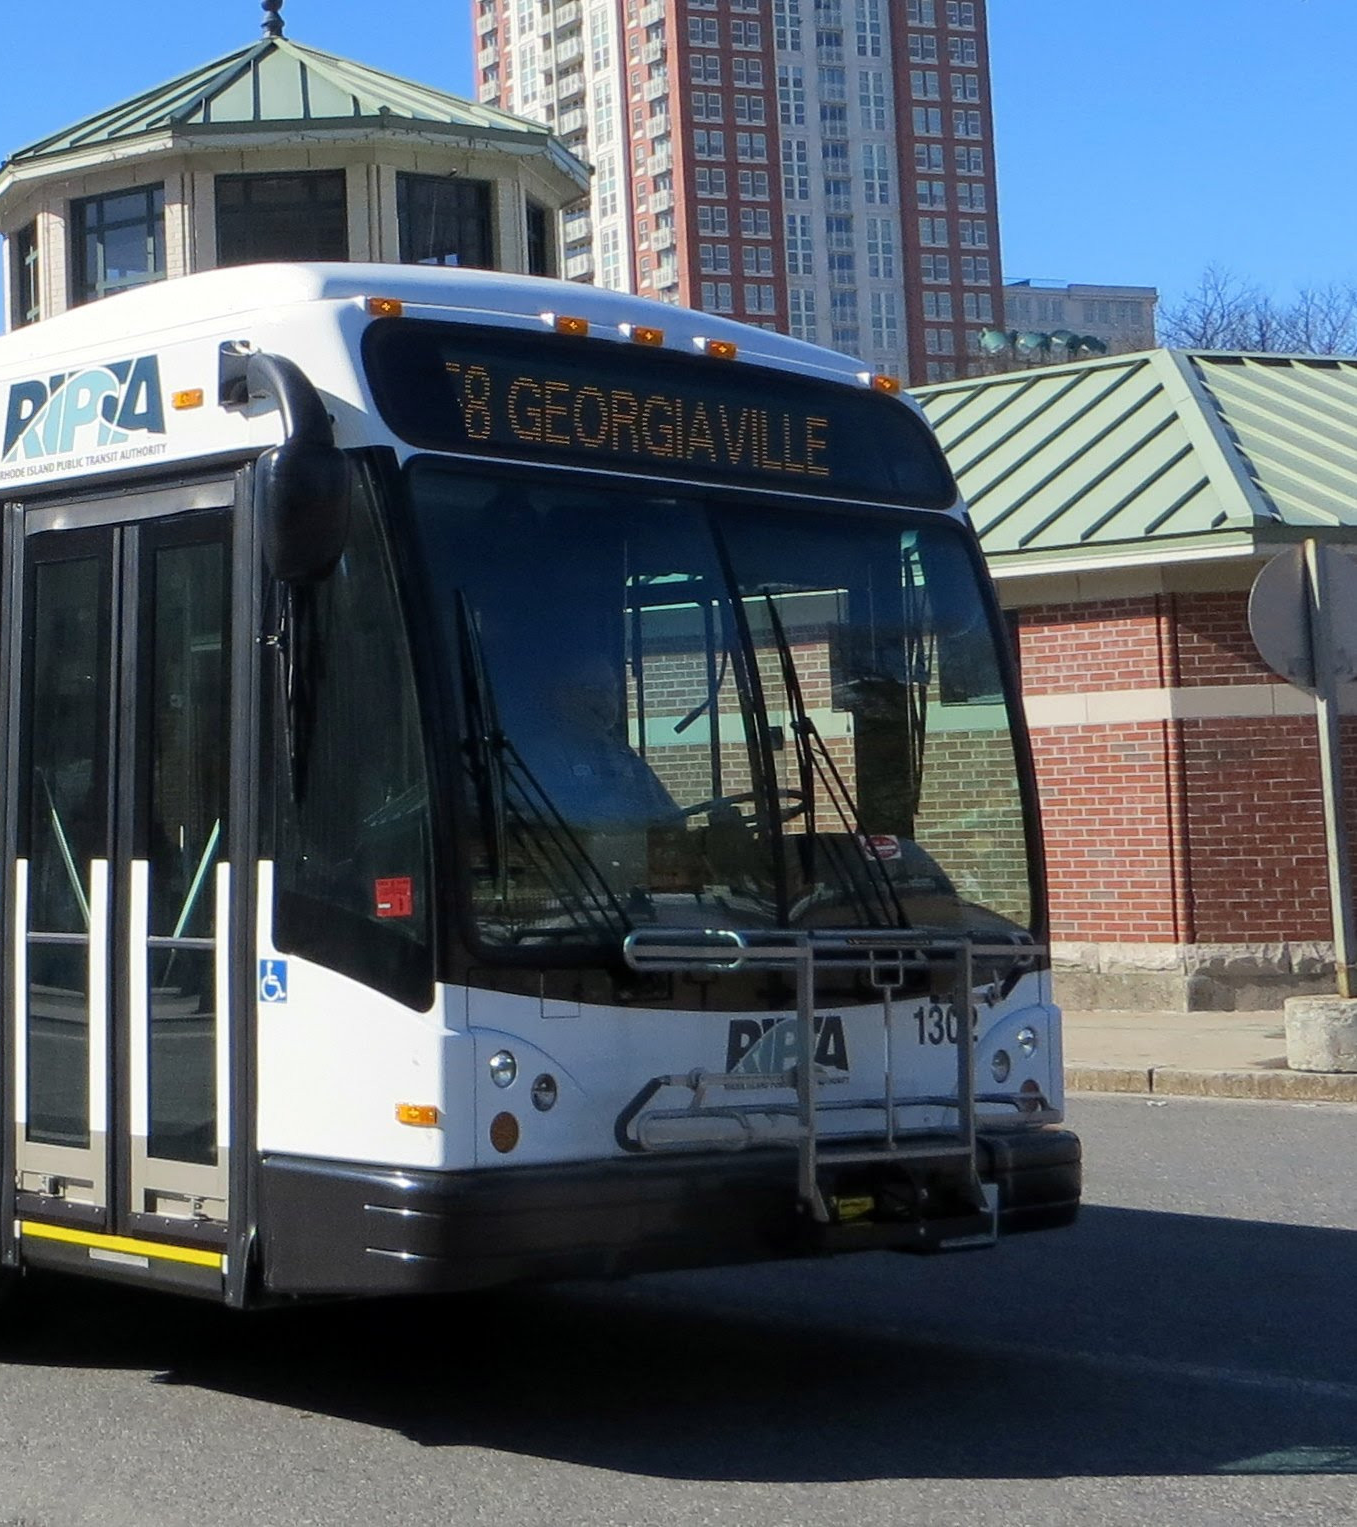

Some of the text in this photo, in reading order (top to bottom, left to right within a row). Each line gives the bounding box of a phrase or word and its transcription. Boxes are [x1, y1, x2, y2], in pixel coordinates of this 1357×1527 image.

[1, 354, 167, 463] RIPTA
[508, 376, 830, 476] GEORGIAVILLE
[0, 443, 168, 480] RHODE ISLAND PUBLIC TRANSIT AUTHORITY
